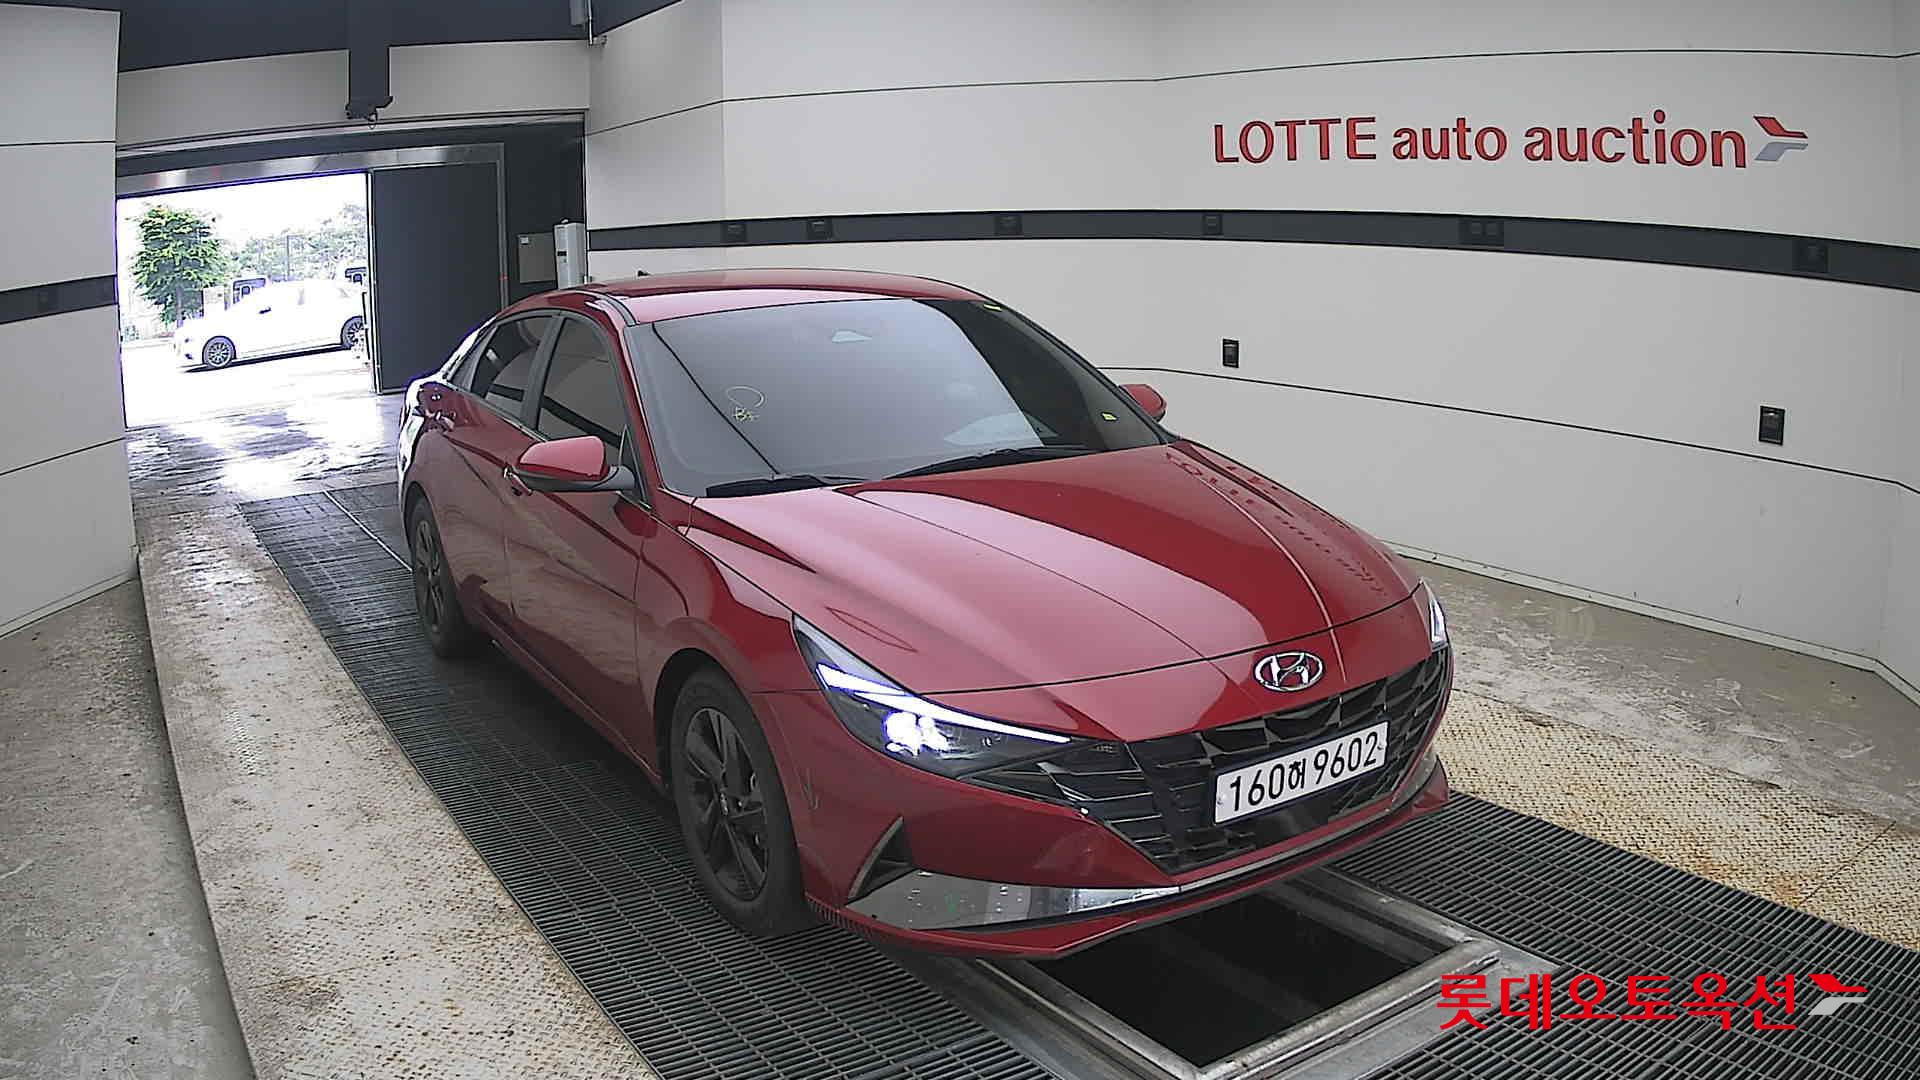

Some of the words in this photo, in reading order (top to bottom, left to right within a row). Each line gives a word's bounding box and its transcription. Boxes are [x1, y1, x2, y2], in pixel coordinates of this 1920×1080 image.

[1215, 117, 1376, 162] LOTTE
[1393, 118, 1508, 161] auto
[1524, 111, 1746, 167] auction
[1313, 732, 1378, 785] 9602
